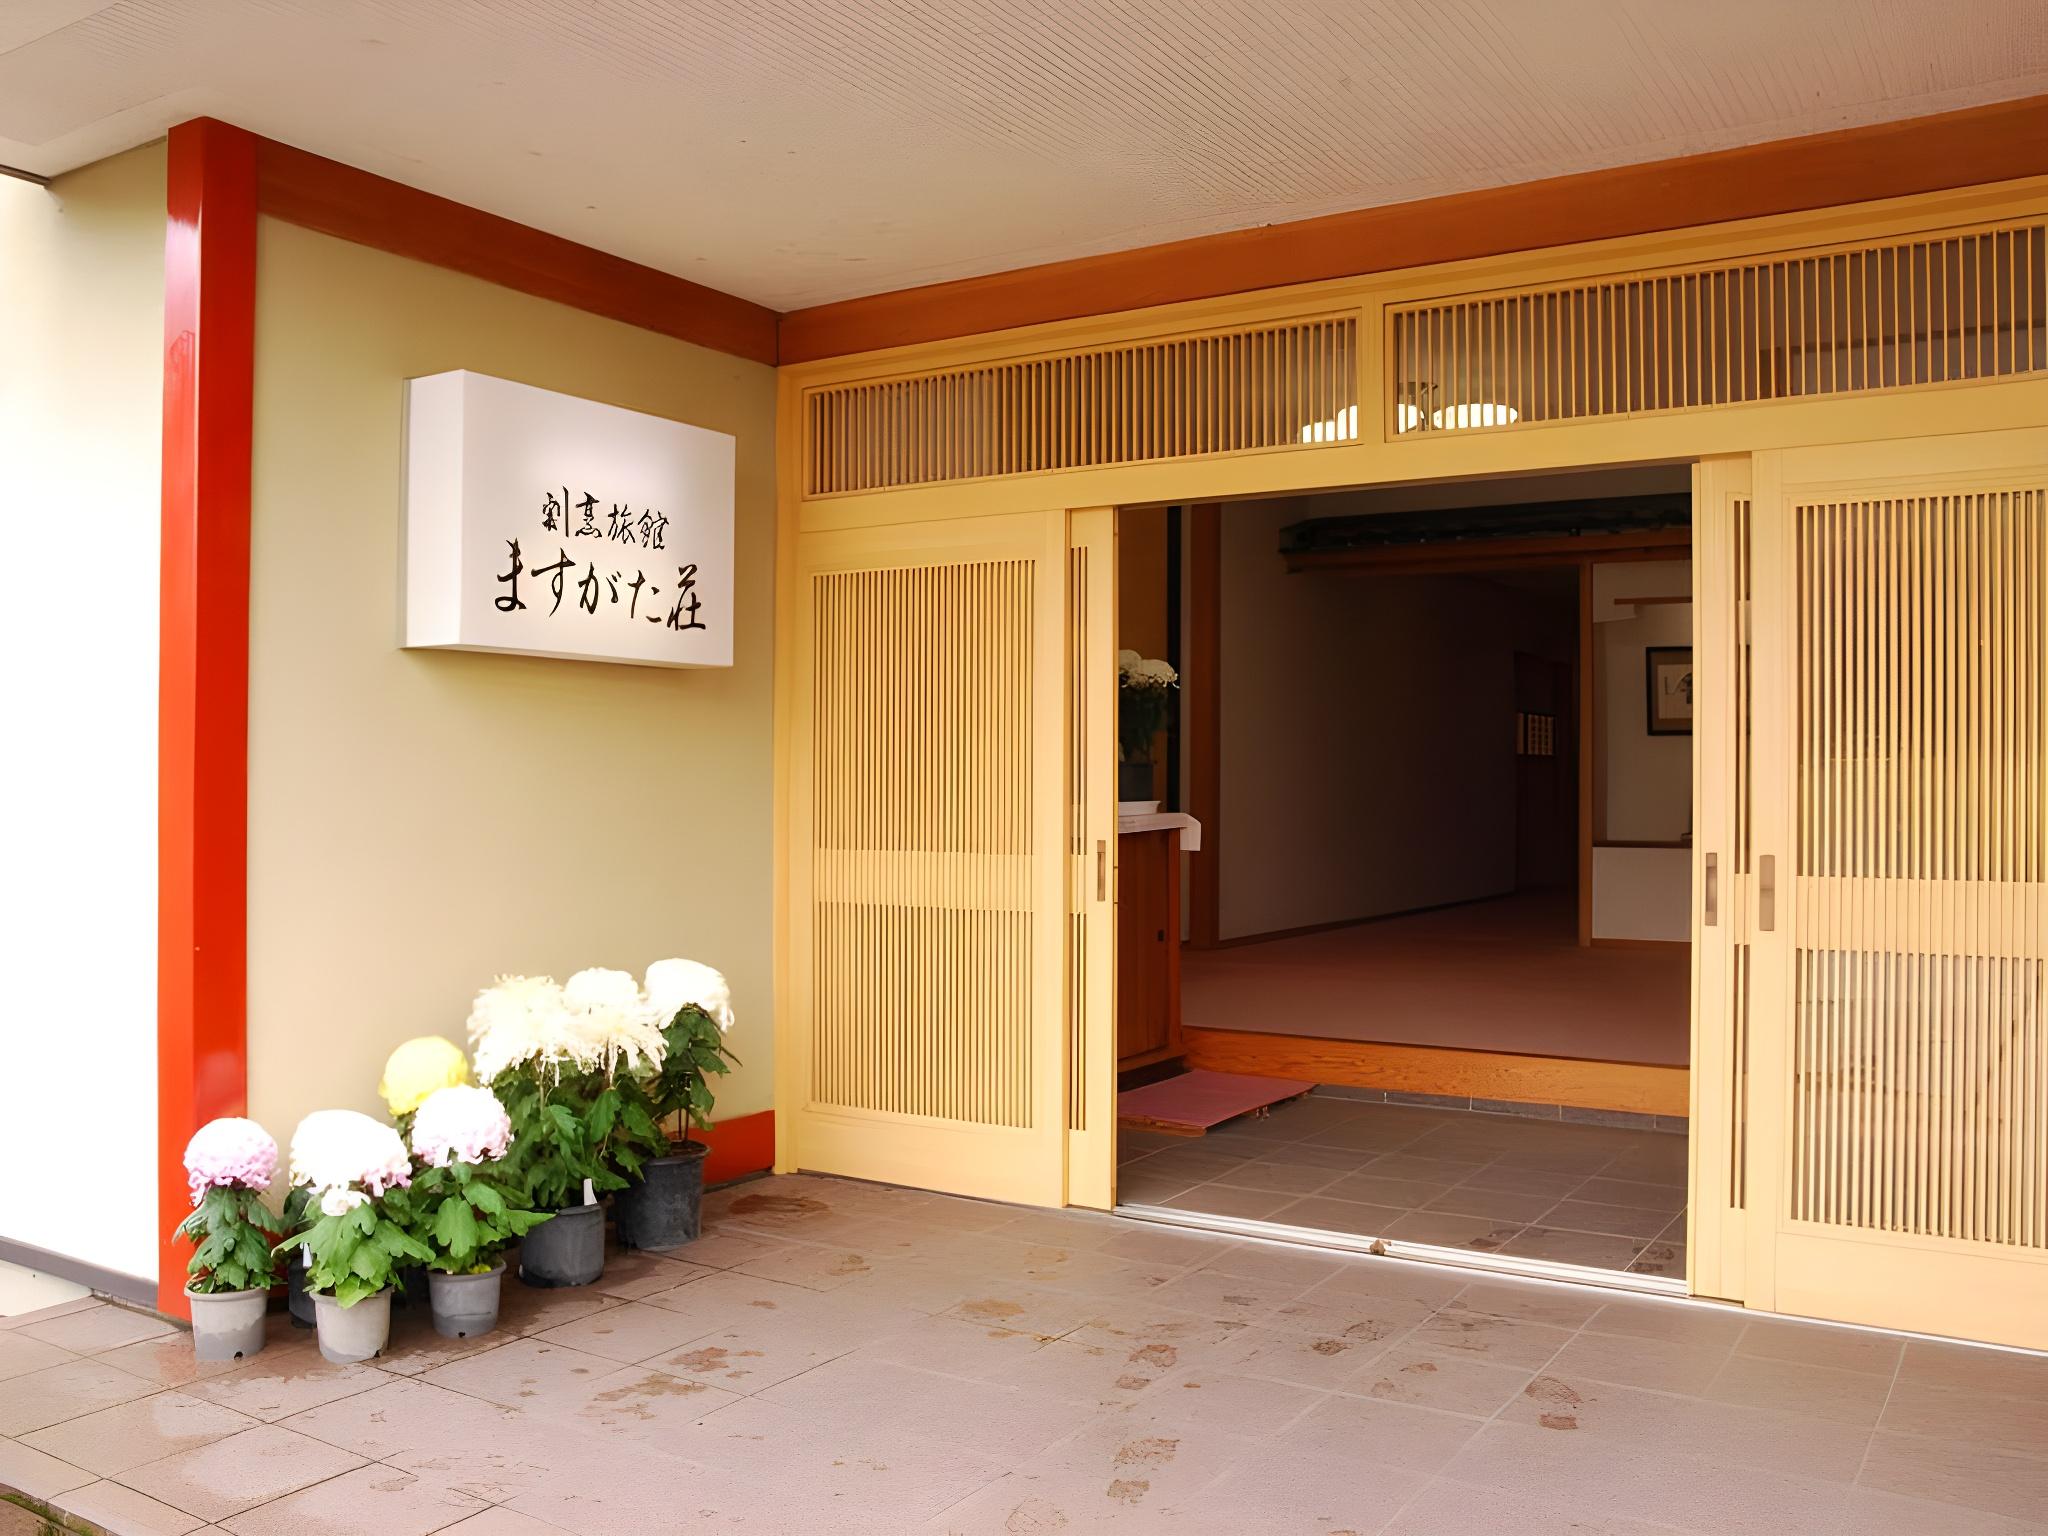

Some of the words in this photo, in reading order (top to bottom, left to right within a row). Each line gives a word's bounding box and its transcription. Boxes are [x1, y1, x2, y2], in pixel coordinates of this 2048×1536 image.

[542, 486, 669, 550] 割烹旅館
[495, 537, 706, 631] ますがた荘
